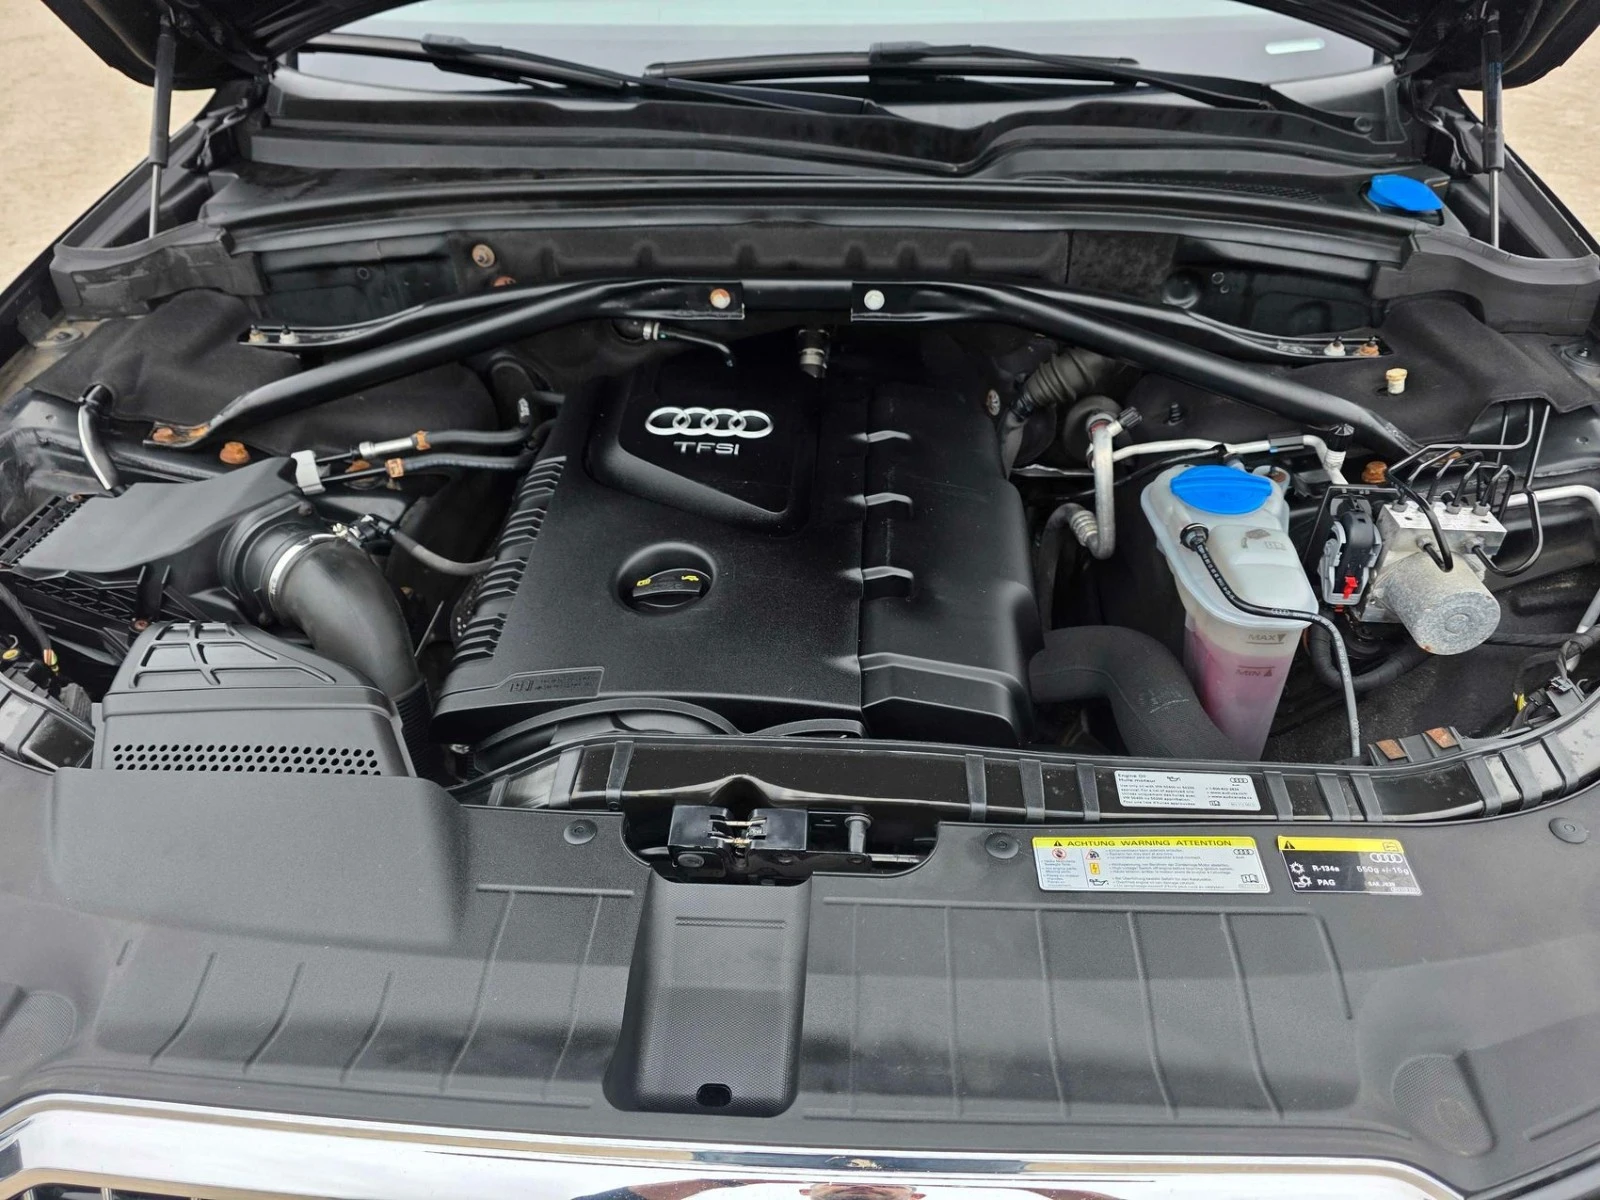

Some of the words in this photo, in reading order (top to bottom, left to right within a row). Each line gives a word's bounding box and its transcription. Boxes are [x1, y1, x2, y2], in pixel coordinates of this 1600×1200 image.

[673, 441, 740, 455] TFSI
[1248, 633, 1276, 641] MAX
[1235, 668, 1260, 677] MIN
